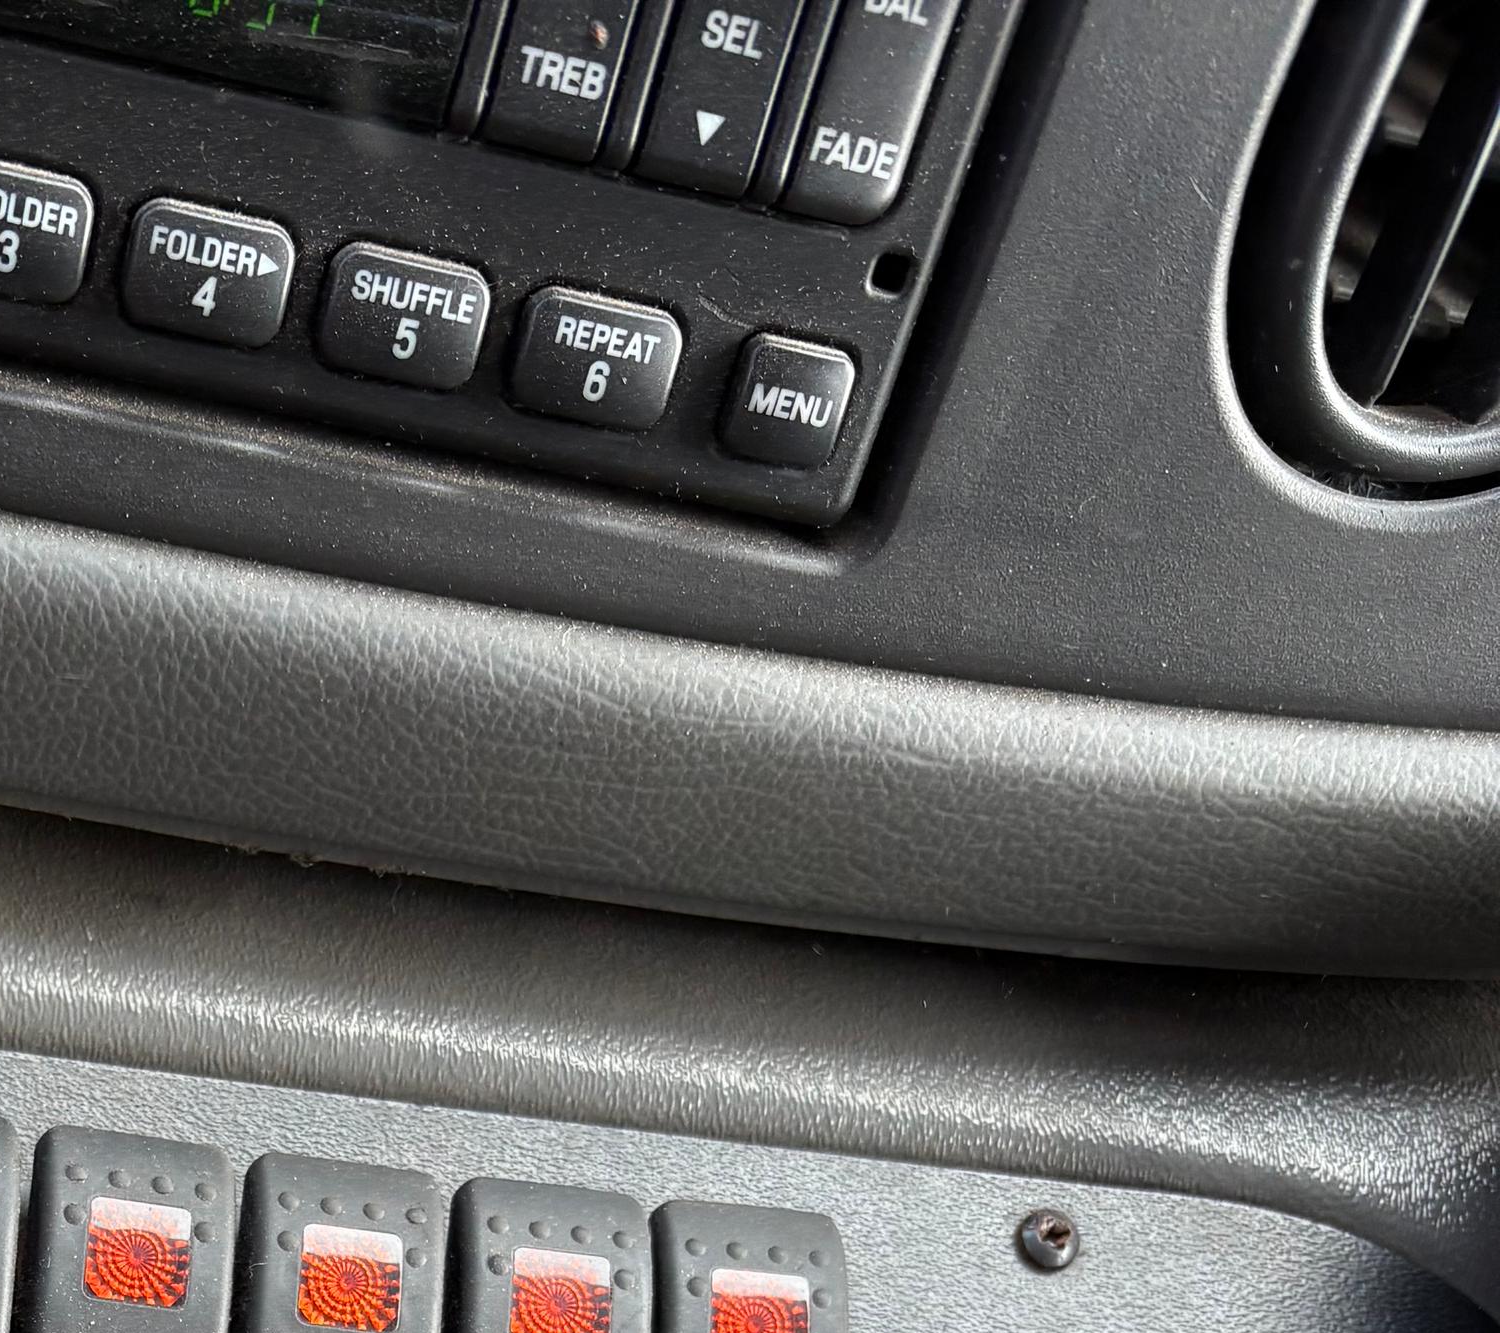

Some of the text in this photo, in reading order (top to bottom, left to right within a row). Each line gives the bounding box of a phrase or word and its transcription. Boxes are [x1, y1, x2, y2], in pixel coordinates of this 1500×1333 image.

[701, 10, 762, 60] SEL
[521, 45, 607, 101] TREB
[809, 127, 898, 180] FADE
[148, 225, 256, 277] FOLDER
[191, 276, 217, 318] 4
[351, 268, 477, 326] SHUFFLE
[392, 319, 420, 360] 5
[555, 316, 662, 366] REPEAT
[582, 360, 610, 403] 6
[747, 383, 836, 430] MENU
